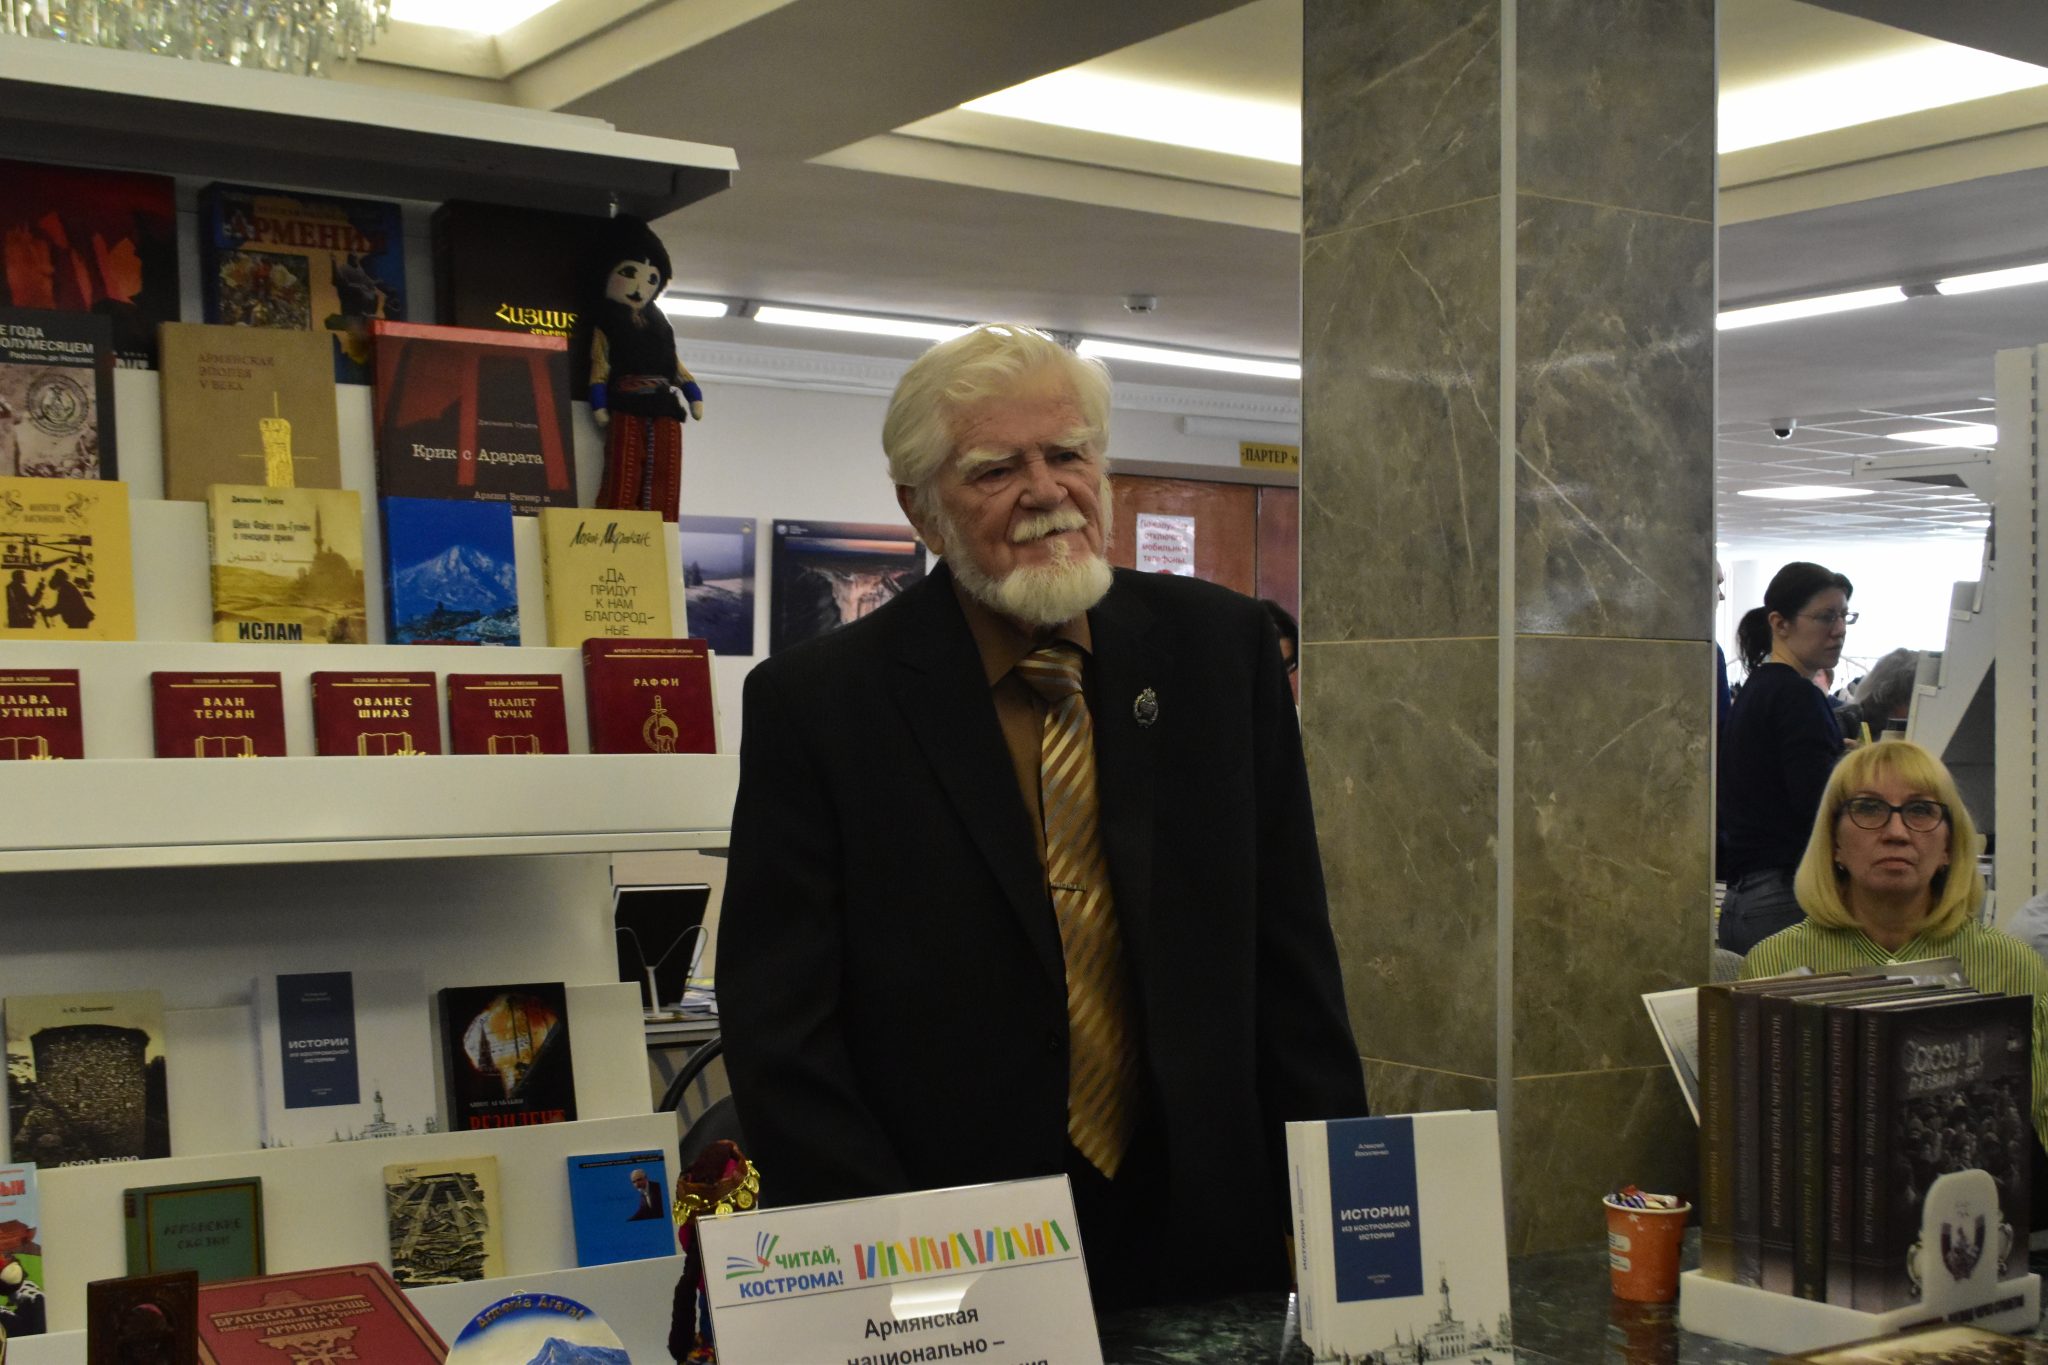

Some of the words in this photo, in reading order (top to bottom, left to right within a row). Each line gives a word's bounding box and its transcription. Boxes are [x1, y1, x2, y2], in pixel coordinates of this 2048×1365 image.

[9, 325, 45, 338] ГОДА
[0, 337, 94, 354] ОЛУМЕСЯЦЕМ
[411, 444, 458, 461] Крик
[463, 450, 472, 460] с
[477, 448, 544, 466] Арарата
[1245, 448, 1288, 465] ПАРТЕР
[590, 584, 638, 597] ПРИДУТ
[596, 599, 604, 609] К
[608, 599, 633, 609] НАМ
[585, 610, 655, 624] БЛАГОРОД-
[238, 623, 303, 641] ИСЛАМ
[605, 625, 630, 636] НЫЕ
[633, 678, 679, 687] РАФФИ
[203, 697, 245, 707] ВААН
[353, 697, 413, 706] ОВАНЕС
[488, 698, 537, 707] НААПЕТ
[1, 707, 68, 717] УТИКЯН
[193, 709, 255, 719] ТЕРЬЯН
[358, 709, 410, 718] ШИРАЗ
[494, 710, 533, 718] КУЧАК
[288, 1037, 349, 1049] ИСТОРИИ
[1340, 1205, 1410, 1221] ИСТОРИИ
[1358, 1231, 1395, 1241] ИСТОРИИ
[775, 1245, 841, 1270] ЧИТАЙ,
[739, 1270, 844, 1298] КОСТРОМА!
[214, 1308, 295, 1328] БРАТСКАЯ
[299, 1300, 371, 1315] ПОМОЩЬ
[266, 1318, 343, 1335] АРМЯНАМ
[864, 1308, 979, 1340] Армянская
